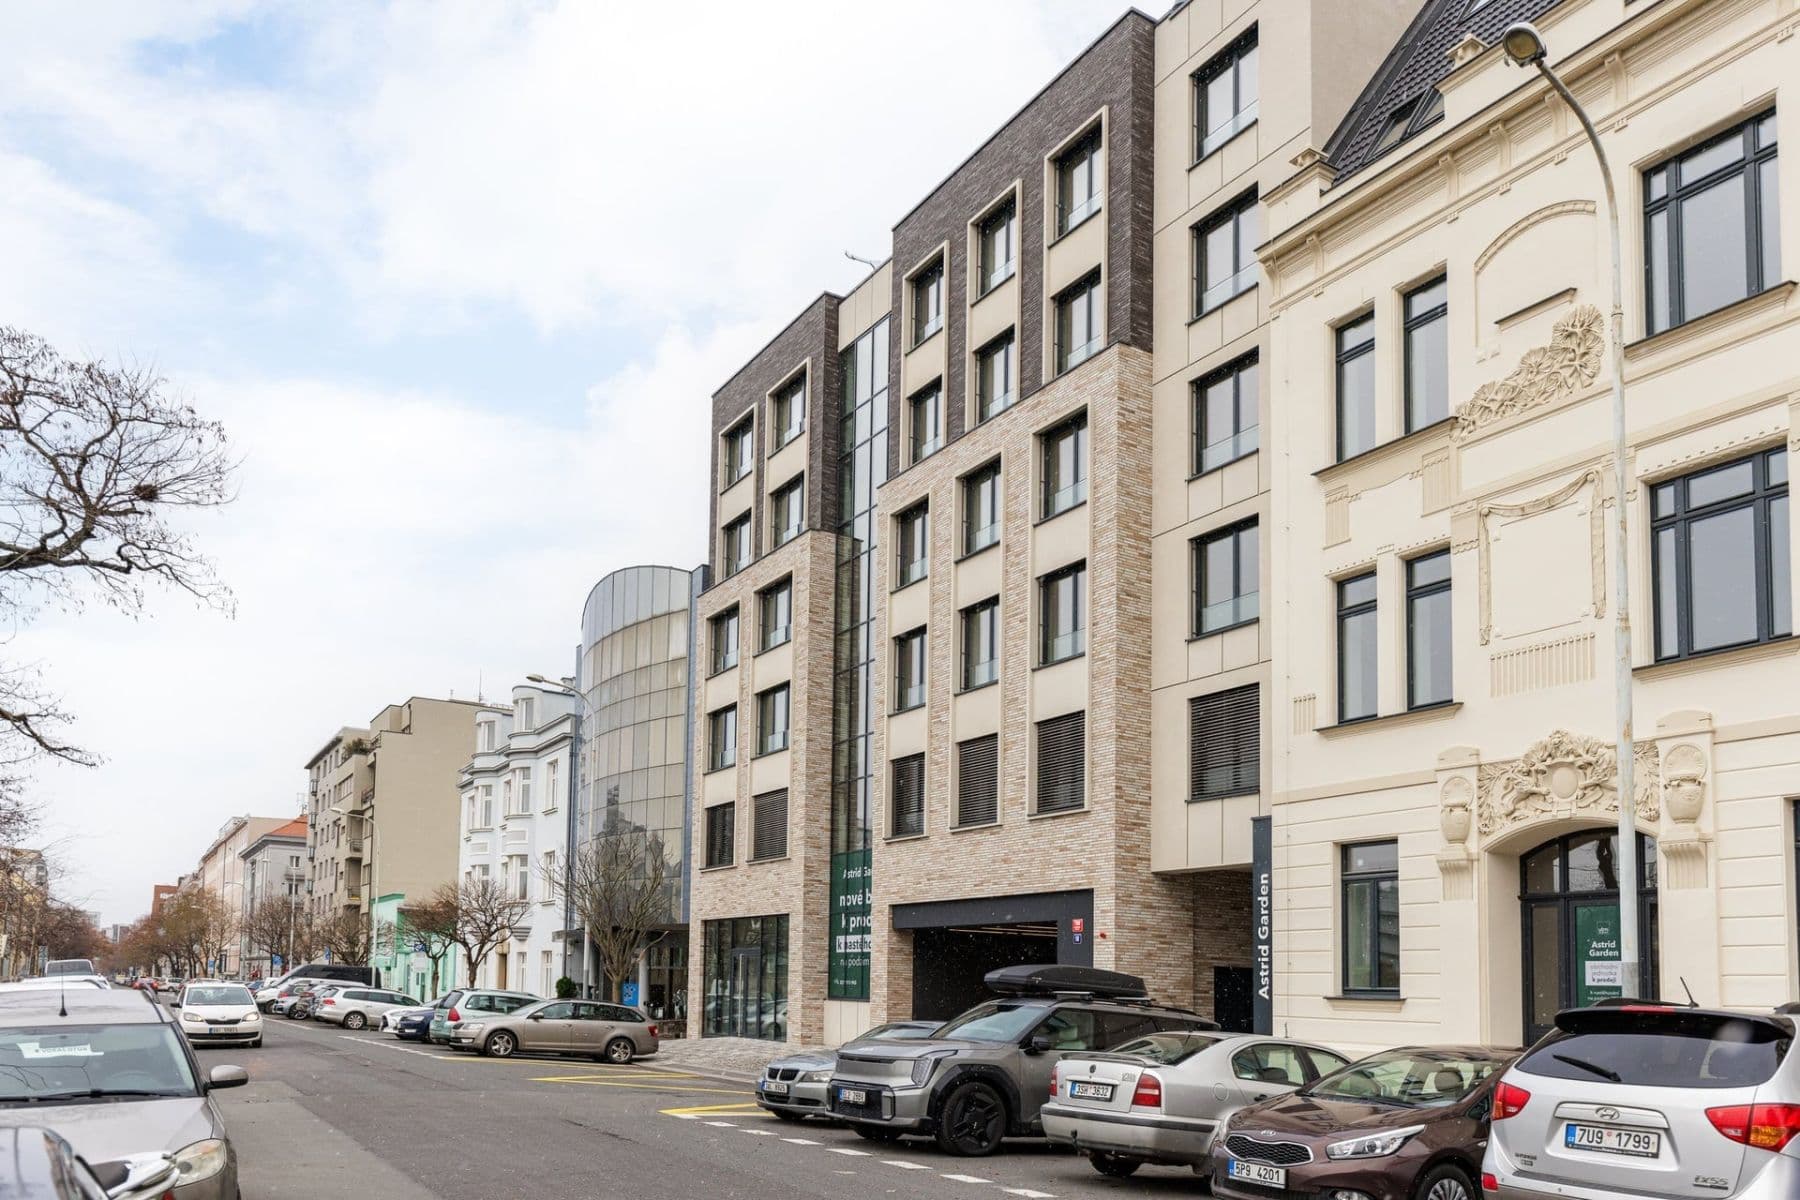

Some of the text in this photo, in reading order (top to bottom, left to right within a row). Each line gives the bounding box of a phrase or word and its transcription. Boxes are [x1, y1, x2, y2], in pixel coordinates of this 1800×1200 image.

[839, 889, 863, 907] nové
[845, 937, 872, 950] asth
[1257, 873, 1270, 1000] Astrid Garden
[1591, 940, 1616, 948] Astrid
[1589, 949, 1619, 957] Garden
[1578, 1128, 1603, 1144] 7U9
[1616, 1132, 1651, 1150] 1799
[1235, 1163, 1280, 1182] 5P9 4201
